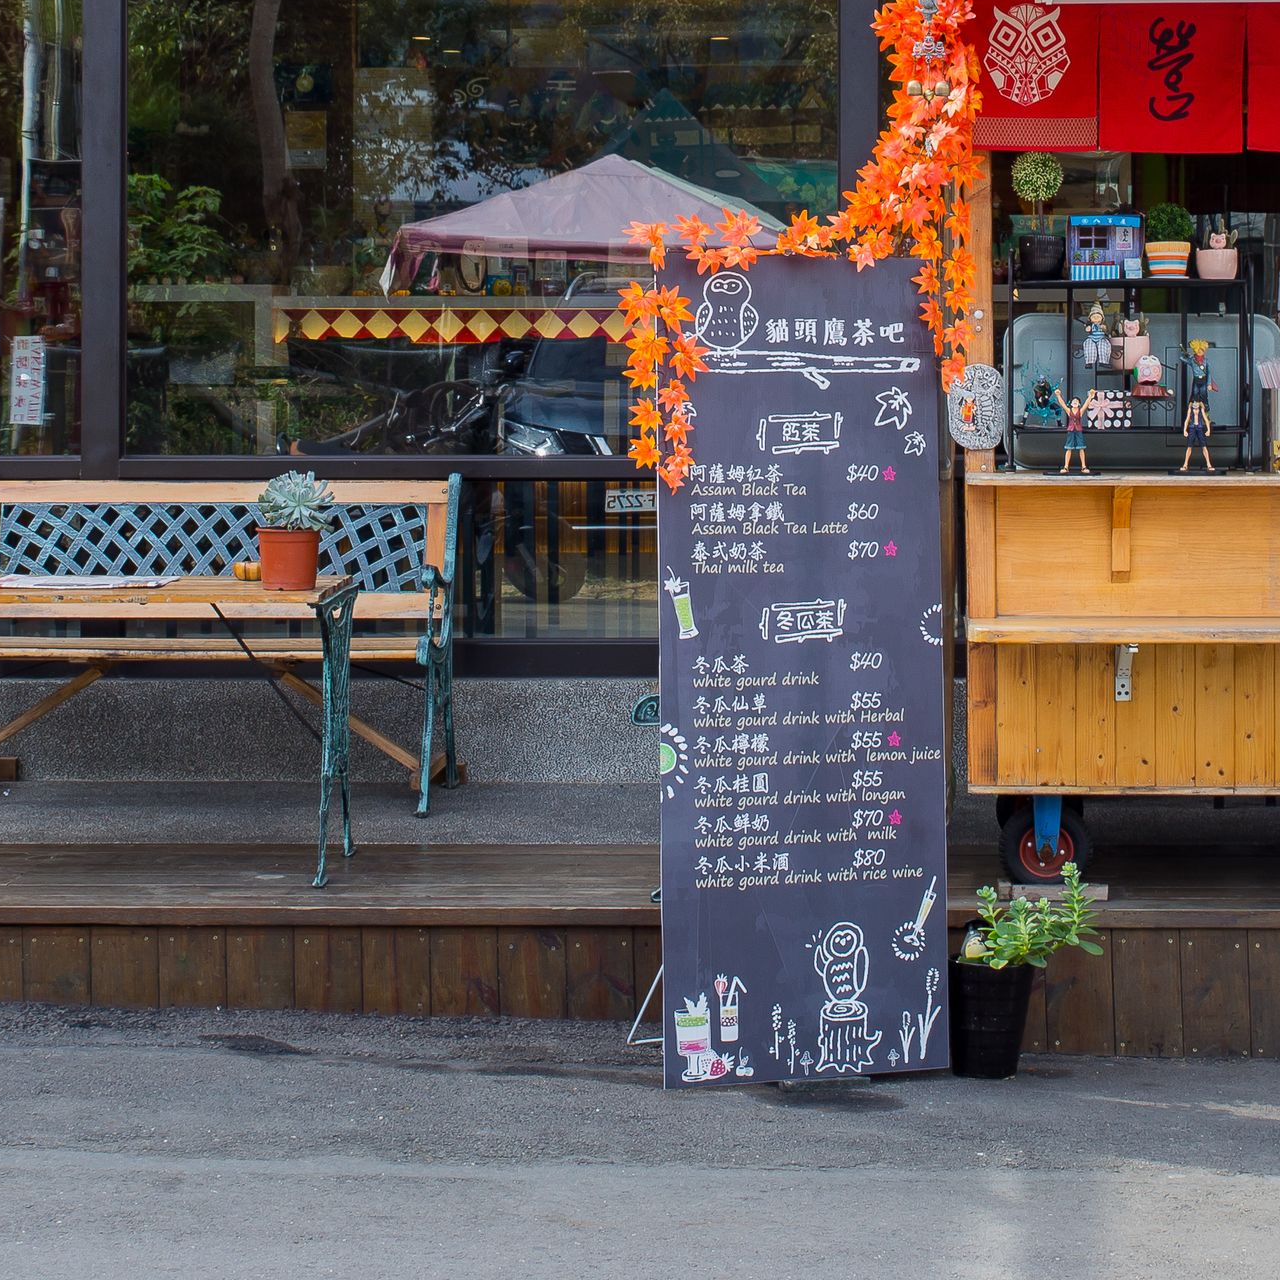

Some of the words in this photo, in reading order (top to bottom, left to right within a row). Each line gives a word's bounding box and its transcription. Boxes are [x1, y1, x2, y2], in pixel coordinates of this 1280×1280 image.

[765, 318, 905, 346] 貓頭鷹茶吧
[782, 422, 820, 442] 紅茶
[847, 464, 879, 482] $40
[691, 483, 736, 496] Assam
[741, 482, 778, 496] Black
[783, 483, 807, 496] Tea
[847, 503, 879, 521] $60
[691, 521, 736, 535] Assam
[742, 521, 779, 535] Black
[784, 522, 808, 535] Tea
[812, 521, 849, 535] Latte
[691, 541, 767, 561] 泰式奶茶
[847, 541, 879, 558] $70
[691, 561, 722, 574] Thai
[727, 560, 759, 574] milk
[764, 562, 785, 574] tea
[776, 609, 833, 630] 冬瓜茶
[692, 655, 749, 674] 冬瓜茶
[850, 652, 882, 670] $40
[693, 674, 731, 688] white
[736, 673, 777, 691] gourd
[782, 672, 819, 685] drink
[693, 694, 767, 714] 冬瓜仙草
[850, 692, 881, 711] $55
[694, 714, 732, 728] white
[736, 713, 777, 731] gourd
[782, 712, 820, 725] drink
[825, 711, 855, 723] with
[861, 708, 904, 722] Herbal
[693, 734, 769, 754] 冬瓜檸檬
[851, 731, 882, 750] $55
[694, 754, 732, 768] white
[737, 752, 778, 771] gourd
[783, 750, 820, 764] drink
[826, 750, 856, 763] with
[866, 748, 907, 761] lemon
[909, 747, 941, 764] juice
[694, 773, 769, 794] 冬瓜桂圓
[851, 769, 883, 788] $55
[694, 794, 733, 808] white
[737, 791, 778, 810] gourd
[783, 790, 820, 805] drink
[826, 789, 856, 802] with
[862, 788, 906, 804] longan
[852, 810, 883, 829] $70
[695, 834, 733, 848] white
[738, 832, 779, 850] gourd
[784, 830, 821, 844] drink
[827, 829, 857, 842] with
[867, 827, 897, 840] milk
[694, 853, 789, 874] 冬瓜小米酒
[853, 849, 885, 867] $80
[696, 875, 734, 889] white
[738, 872, 779, 890] gourd
[785, 870, 822, 884] drink
[827, 869, 857, 881] with
[863, 868, 887, 879] rice
[892, 865, 923, 878] wine
